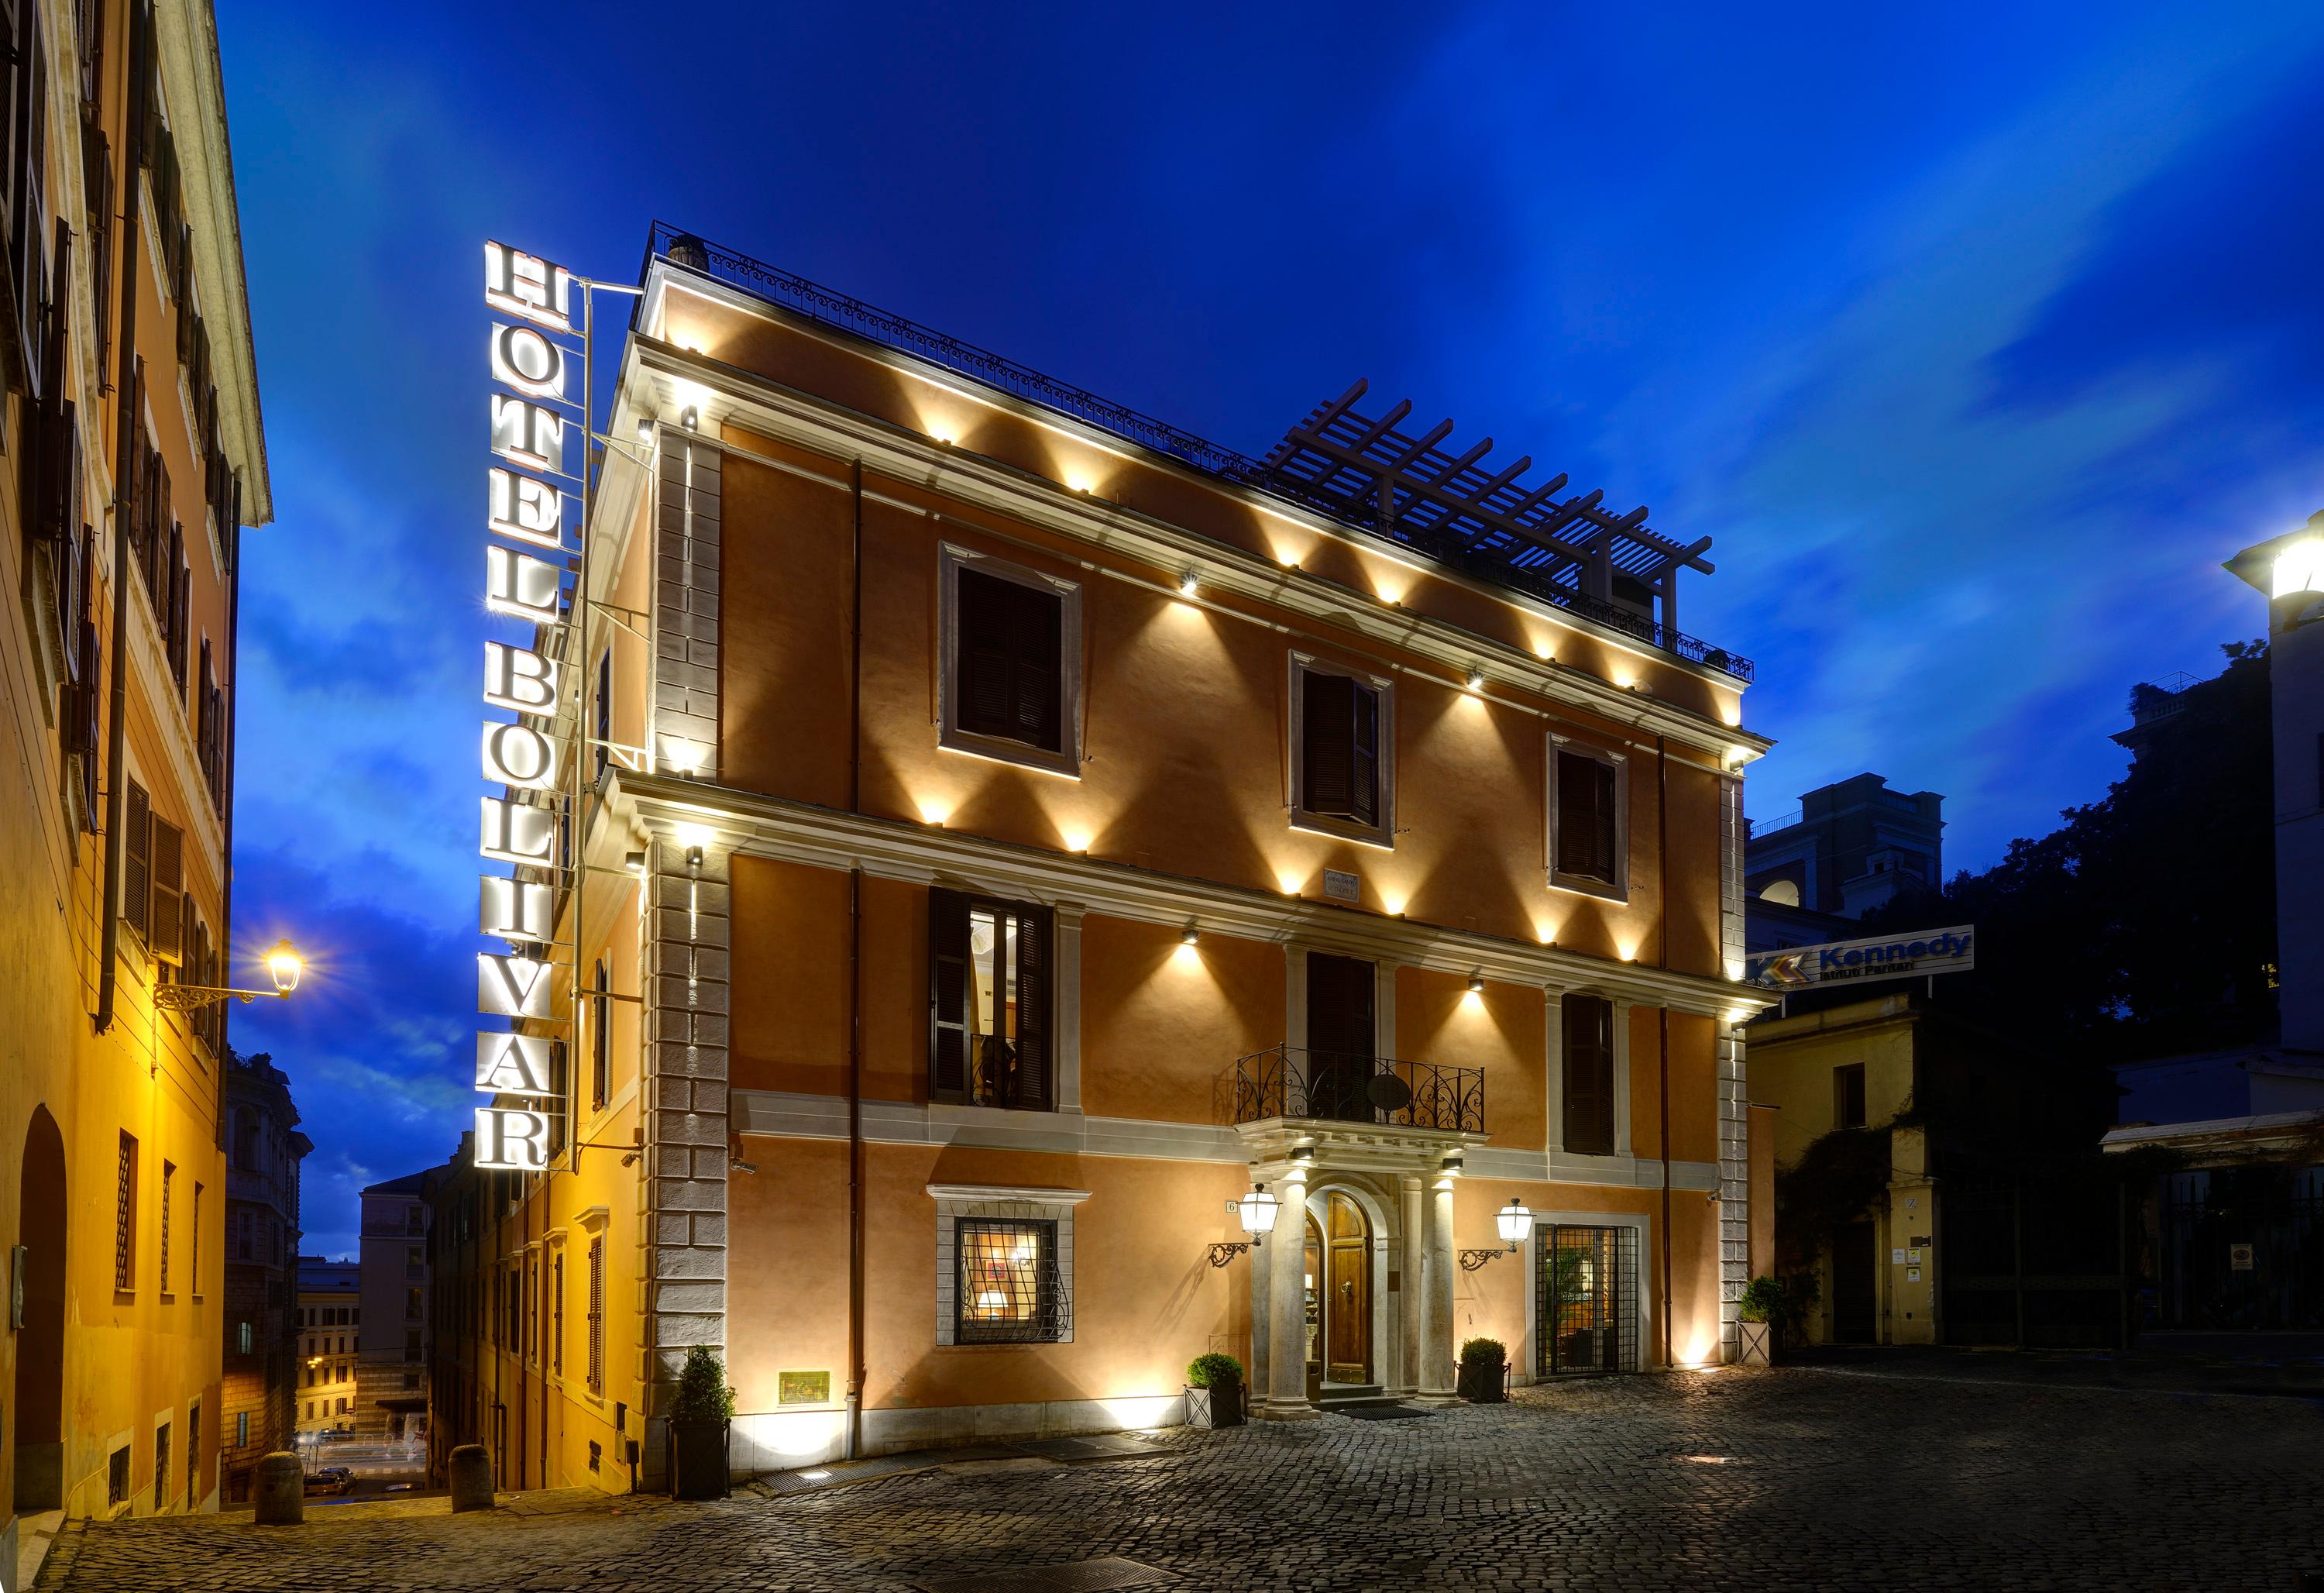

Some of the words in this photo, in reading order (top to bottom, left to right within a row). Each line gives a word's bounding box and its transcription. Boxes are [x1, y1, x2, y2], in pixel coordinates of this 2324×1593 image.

[486, 239, 569, 623] HOTEL
[476, 641, 556, 1168] BOLIVAR
[1820, 932, 1971, 968] Kennedy
[1229, 1202, 1235, 1212] 6
